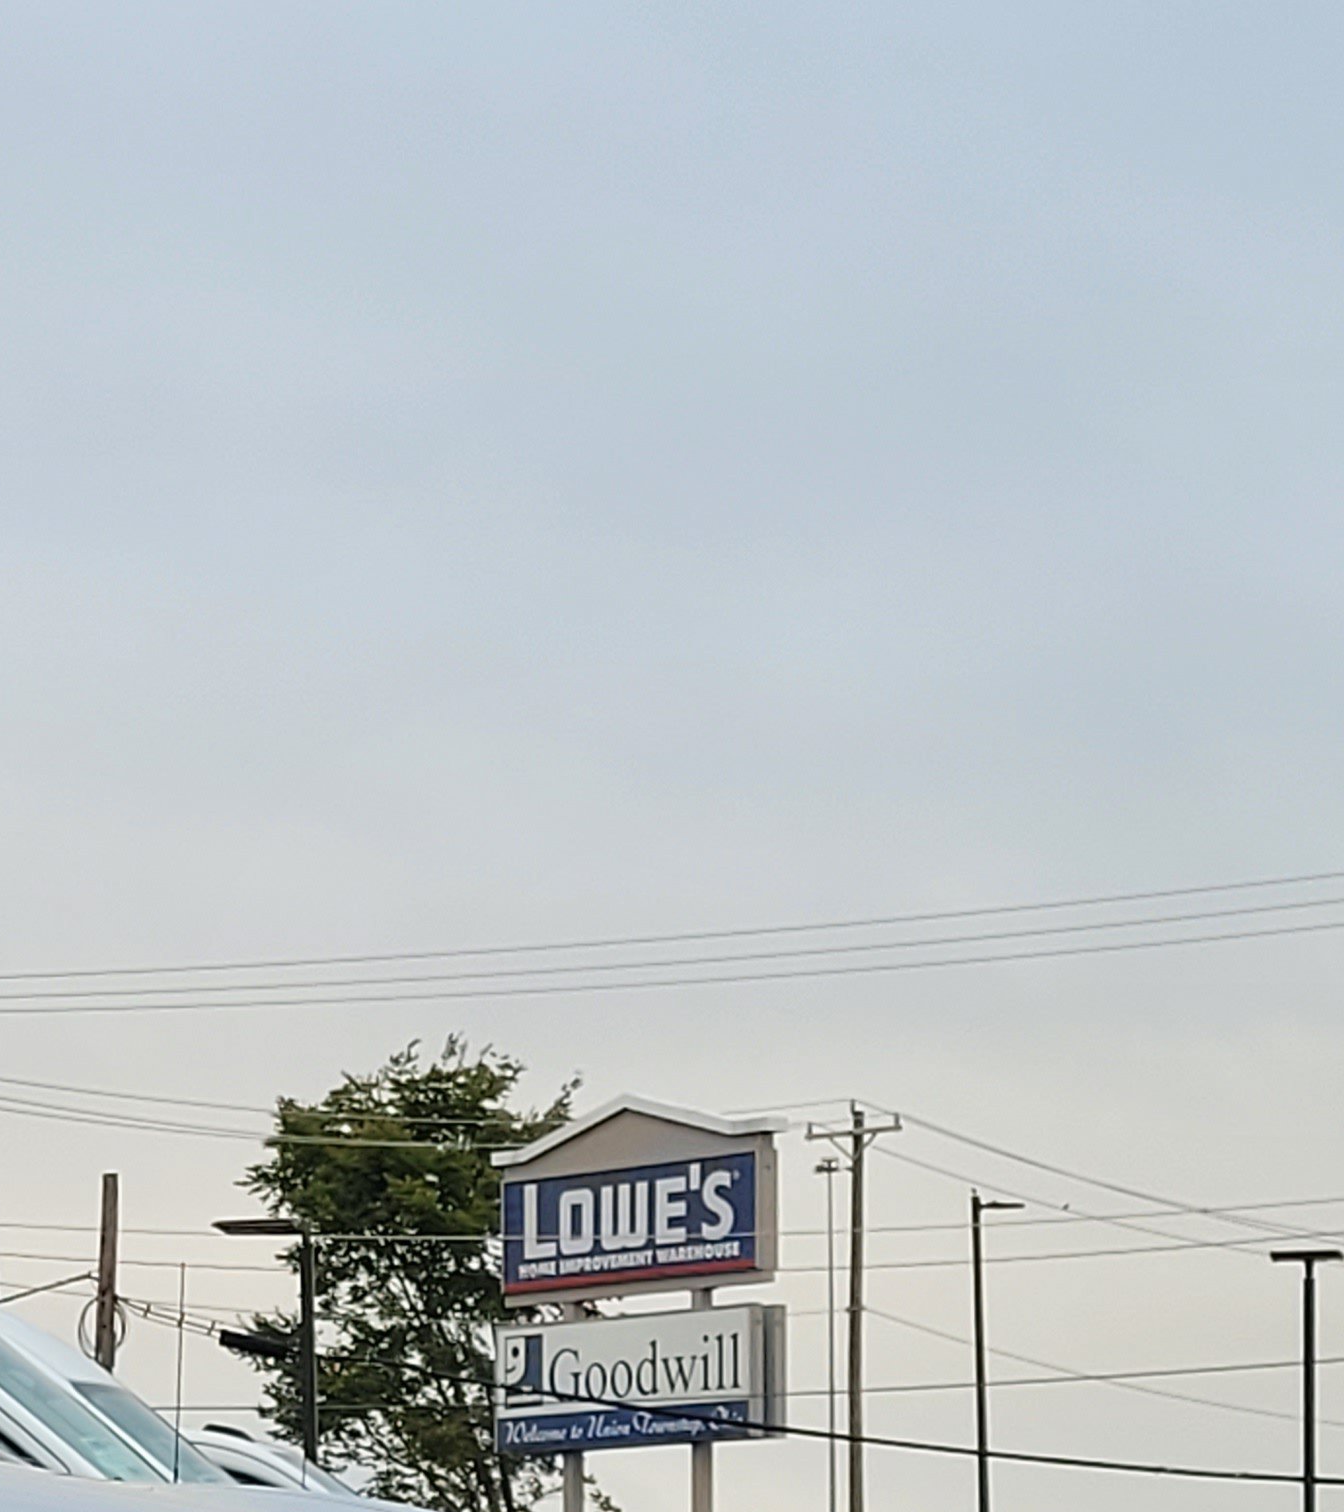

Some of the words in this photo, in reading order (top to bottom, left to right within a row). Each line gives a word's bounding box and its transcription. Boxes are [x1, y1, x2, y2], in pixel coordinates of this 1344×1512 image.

[523, 1162, 736, 1261] LOWE'S
[518, 1260, 557, 1280] HOME
[559, 1251, 654, 1275] IMPROVEMENT
[655, 1241, 741, 1264] WAREHOUSE
[549, 1332, 742, 1401] Goodwill
